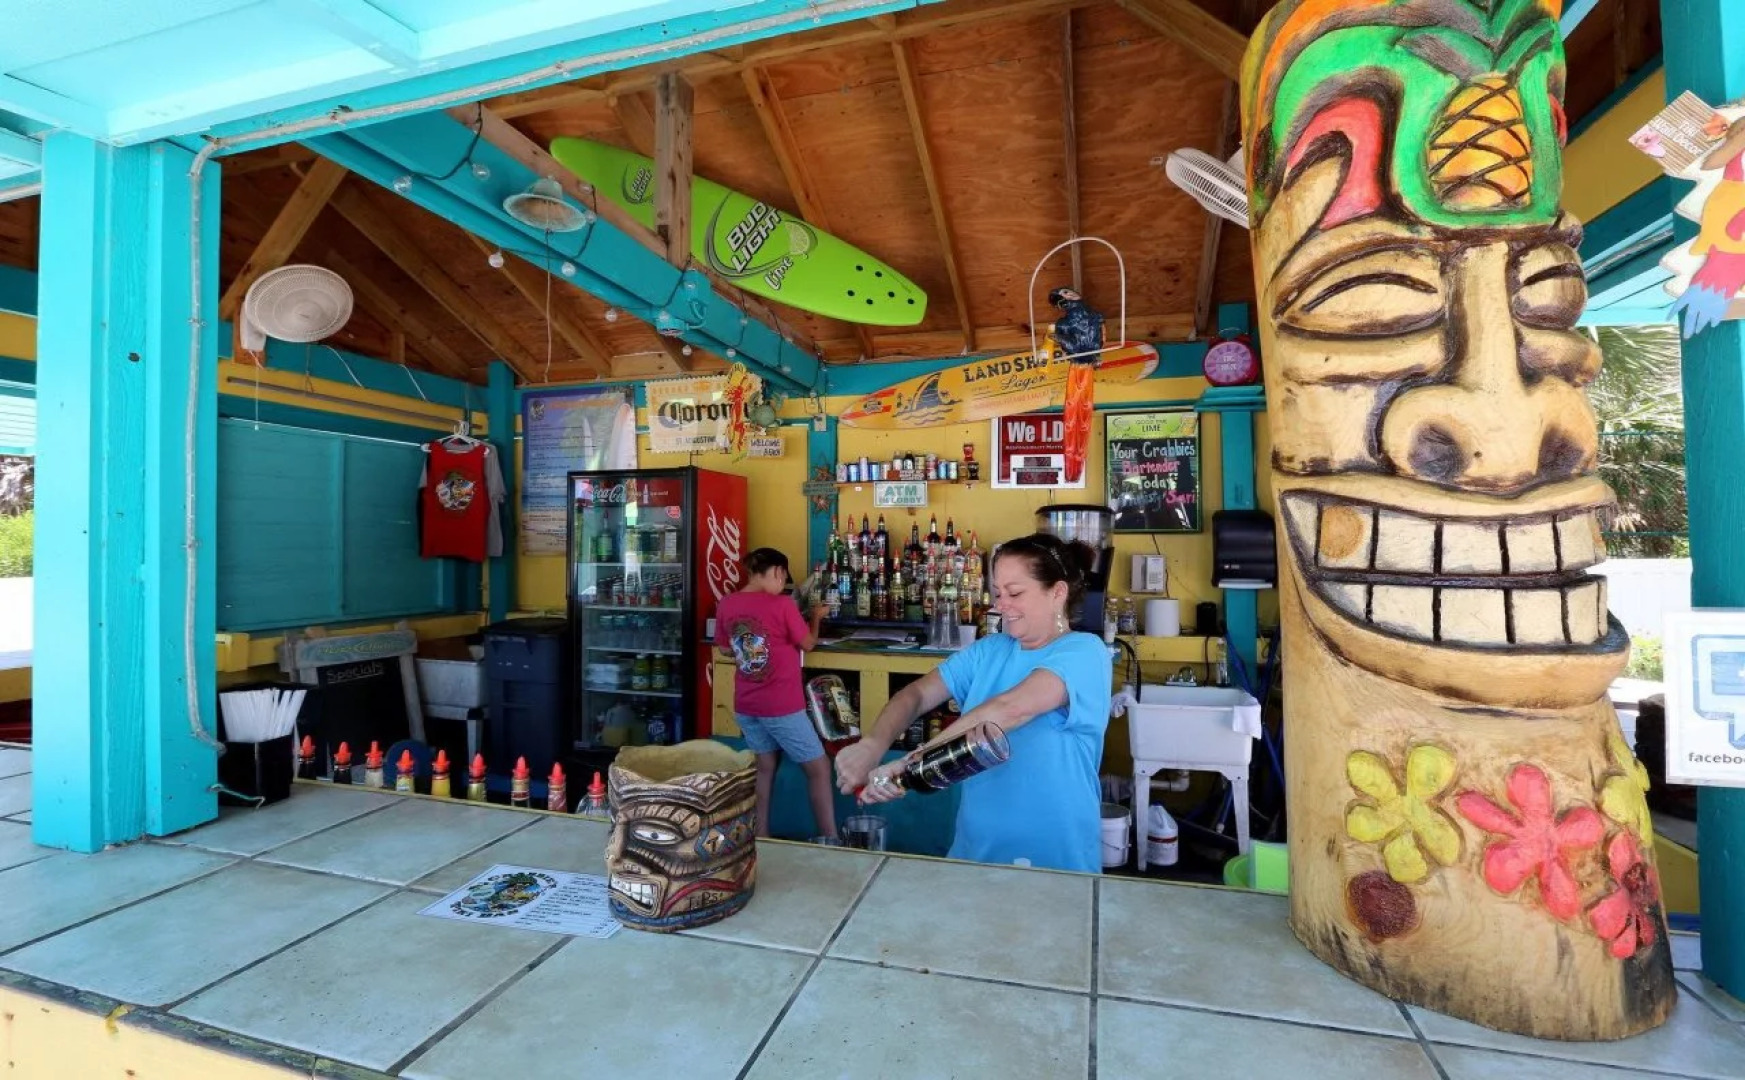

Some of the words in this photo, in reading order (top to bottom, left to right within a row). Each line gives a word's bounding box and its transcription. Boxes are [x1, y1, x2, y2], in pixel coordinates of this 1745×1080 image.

[727, 201, 768, 252] BUD
[731, 207, 782, 274] LIGHT
[1007, 421, 1036, 443] We
[1142, 423, 1161, 432] LIME
[1111, 441, 1138, 459] Your
[1121, 459, 1180, 475] Bartender
[884, 485, 917, 496] ATM
[1688, 752, 1745, 764] facebo
